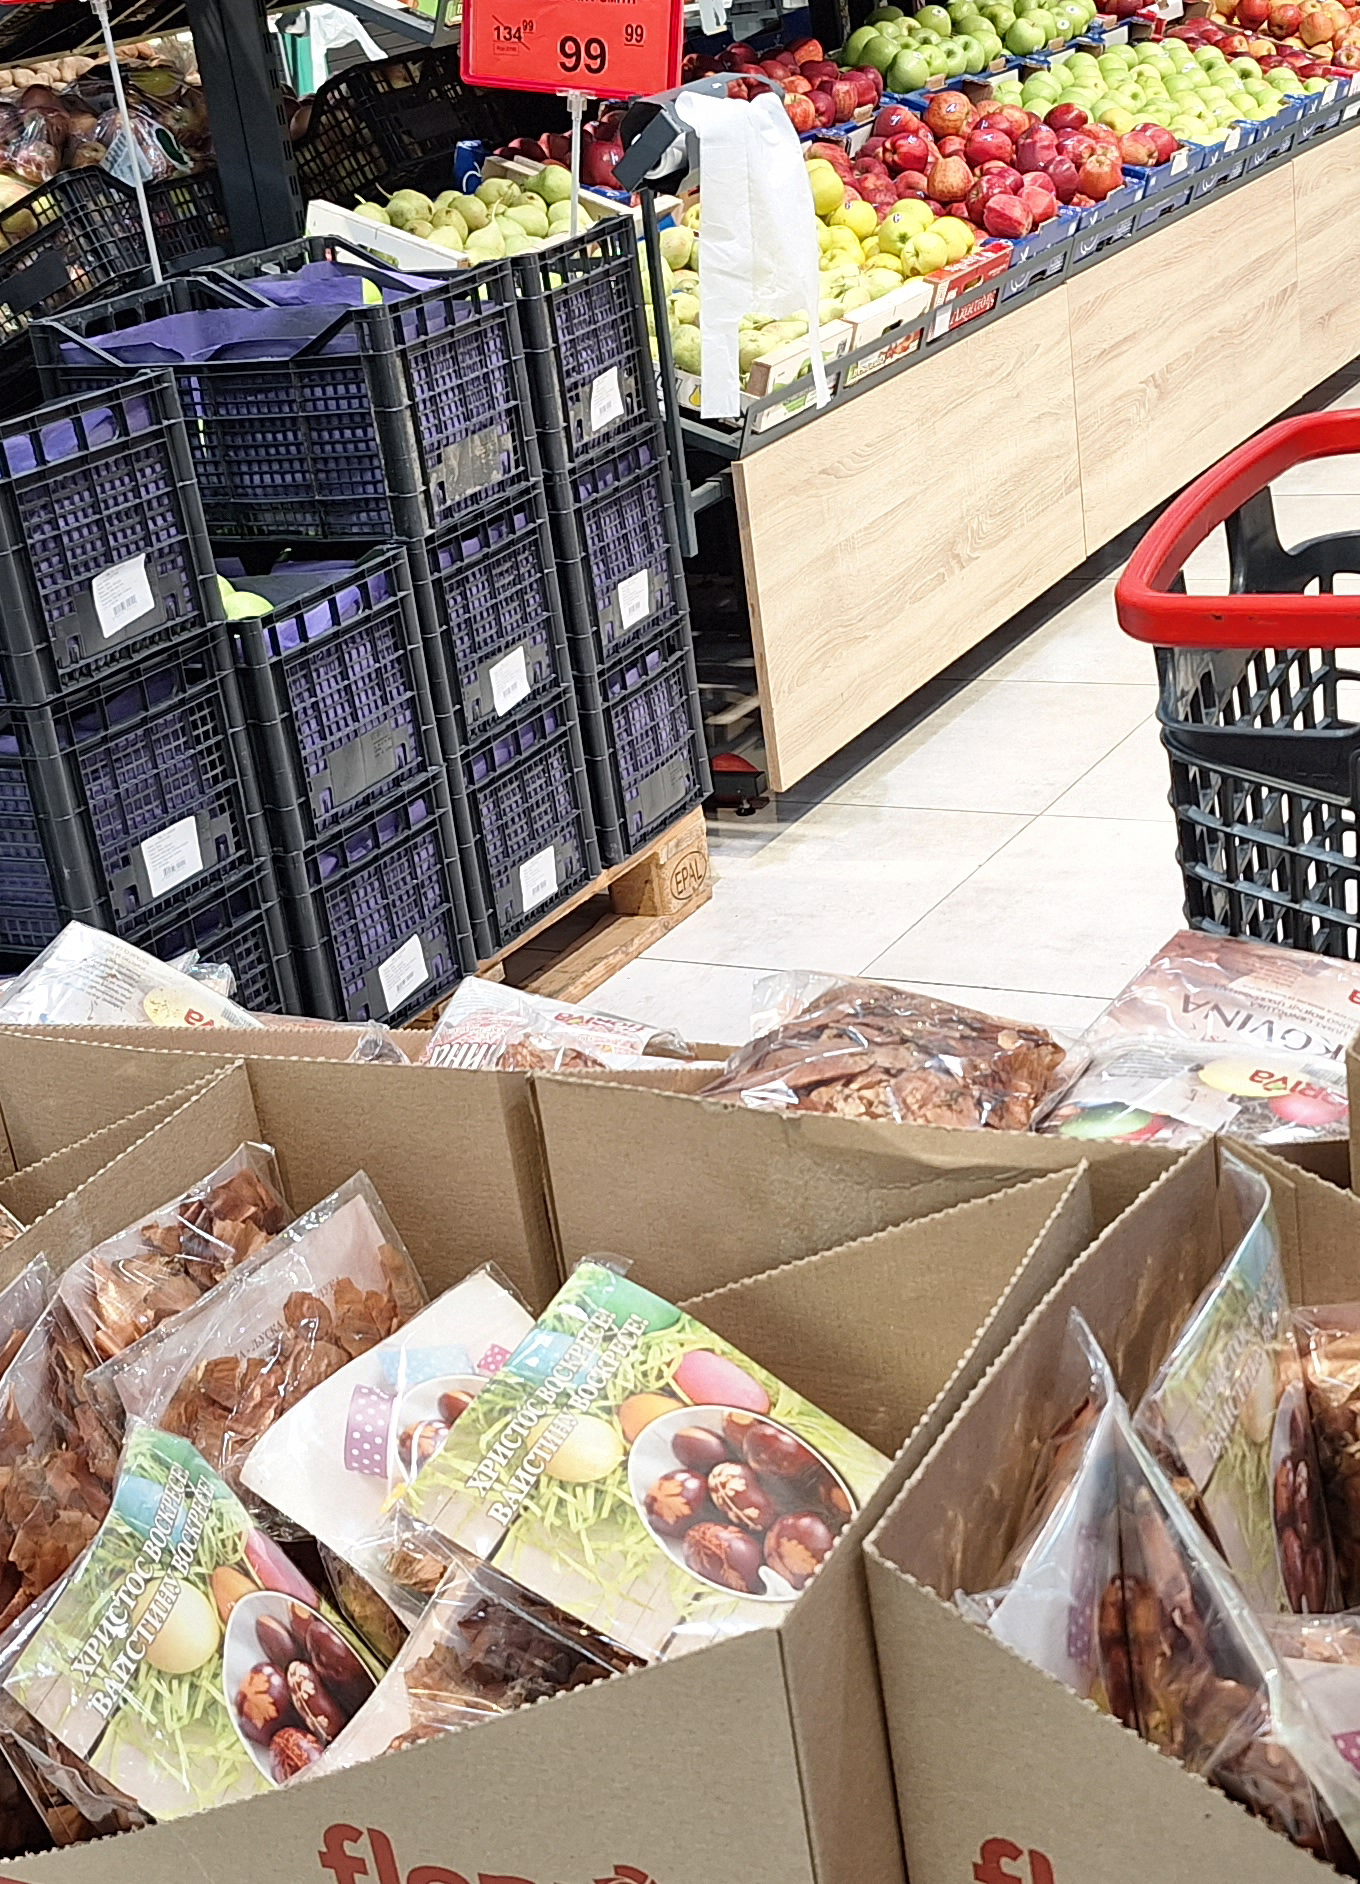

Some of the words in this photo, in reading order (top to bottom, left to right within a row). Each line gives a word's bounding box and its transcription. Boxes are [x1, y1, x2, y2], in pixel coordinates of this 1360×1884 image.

[493, 25, 522, 42] 134
[559, 36, 607, 74] 99
[624, 23, 644, 43] 99
[675, 859, 703, 896] EPAL
[1182, 993, 1346, 1061] KOVINA
[465, 1398, 548, 1497] ХРИСТОС
[536, 1308, 617, 1404] ВОСКРЕСЕ!
[488, 1407, 579, 1526] ВАИСТИНУ
[569, 1313, 649, 1412] ВОСКРЕСЕ!
[71, 1557, 155, 1683] ХРИСТОС
[88, 1568, 182, 1718] ВАИСТИНУ
